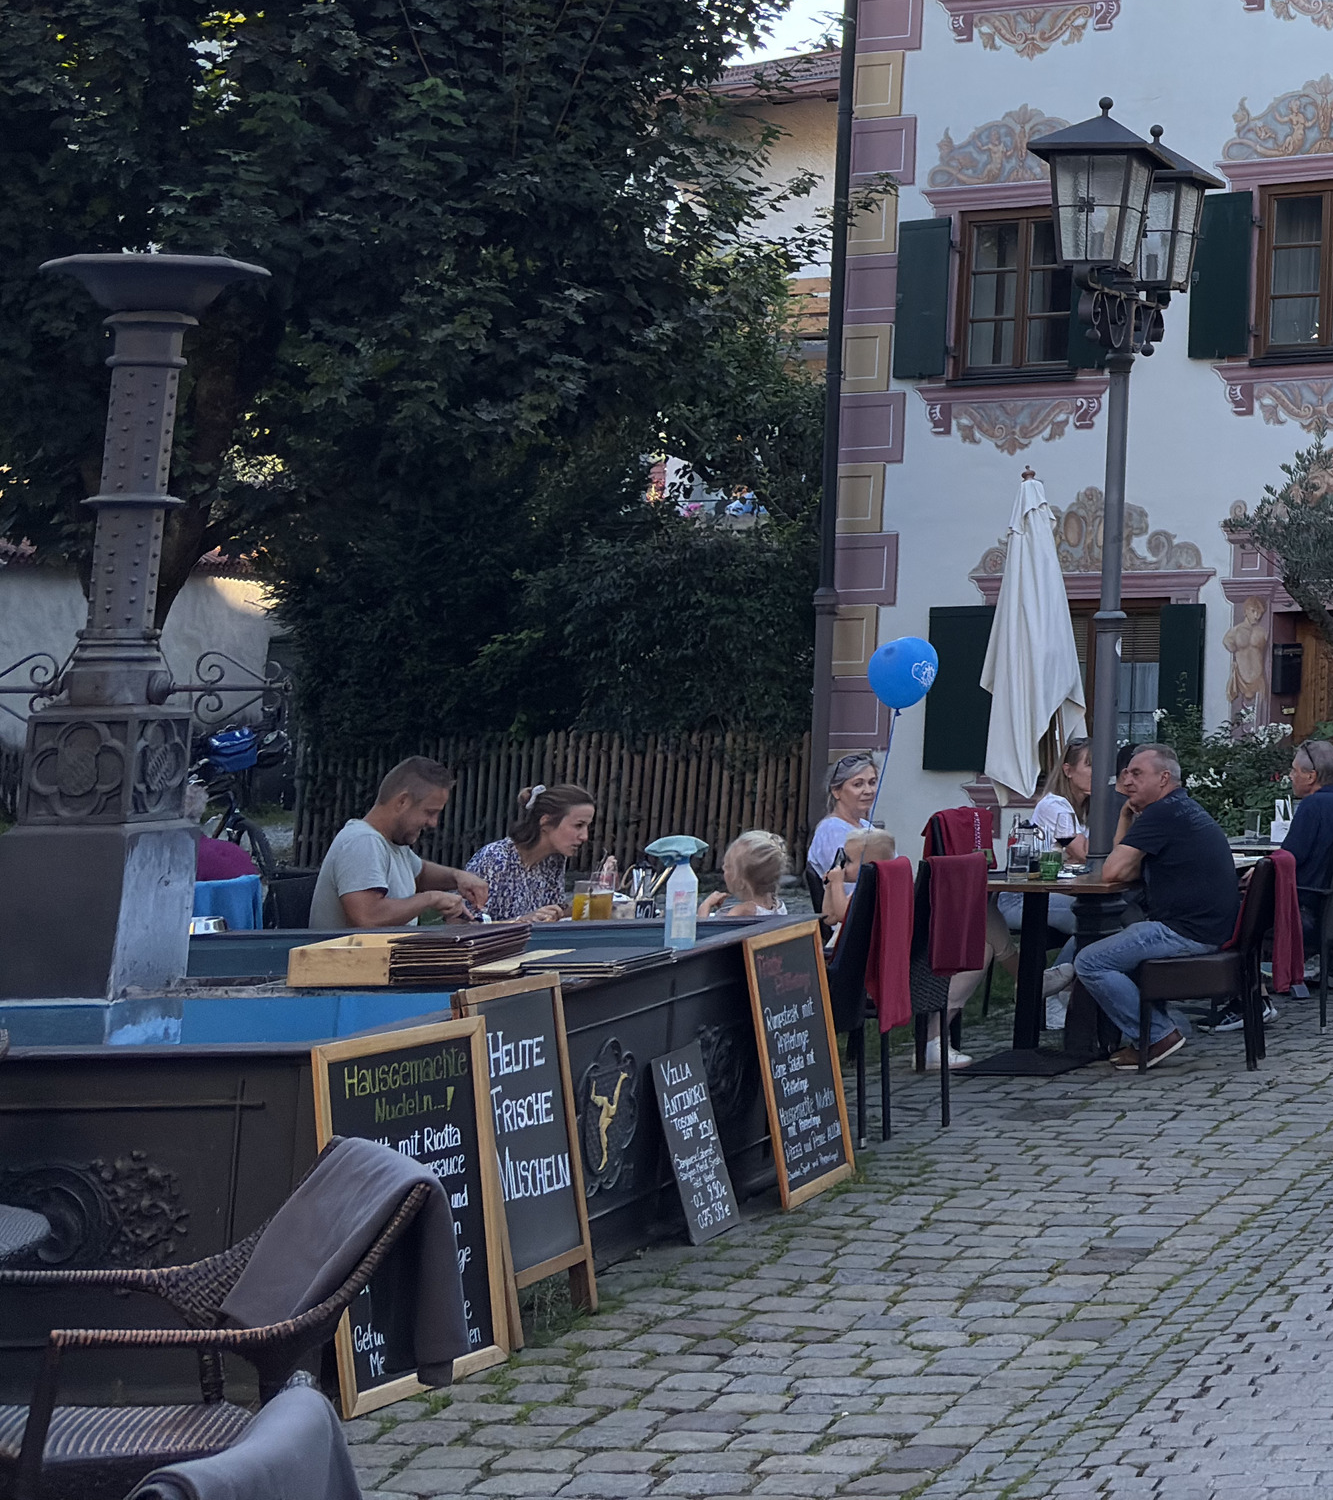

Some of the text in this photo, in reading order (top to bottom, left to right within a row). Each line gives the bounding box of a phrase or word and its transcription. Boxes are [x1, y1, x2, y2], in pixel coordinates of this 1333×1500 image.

[487, 1031, 546, 1078] HEUTE
[660, 1060, 692, 1087] VILLA
[490, 1085, 554, 1135] FRISCHE
[399, 1123, 461, 1156] mit Ricotta
[496, 1146, 571, 1202] MUSCHELN
[451, 1184, 468, 1208] und
